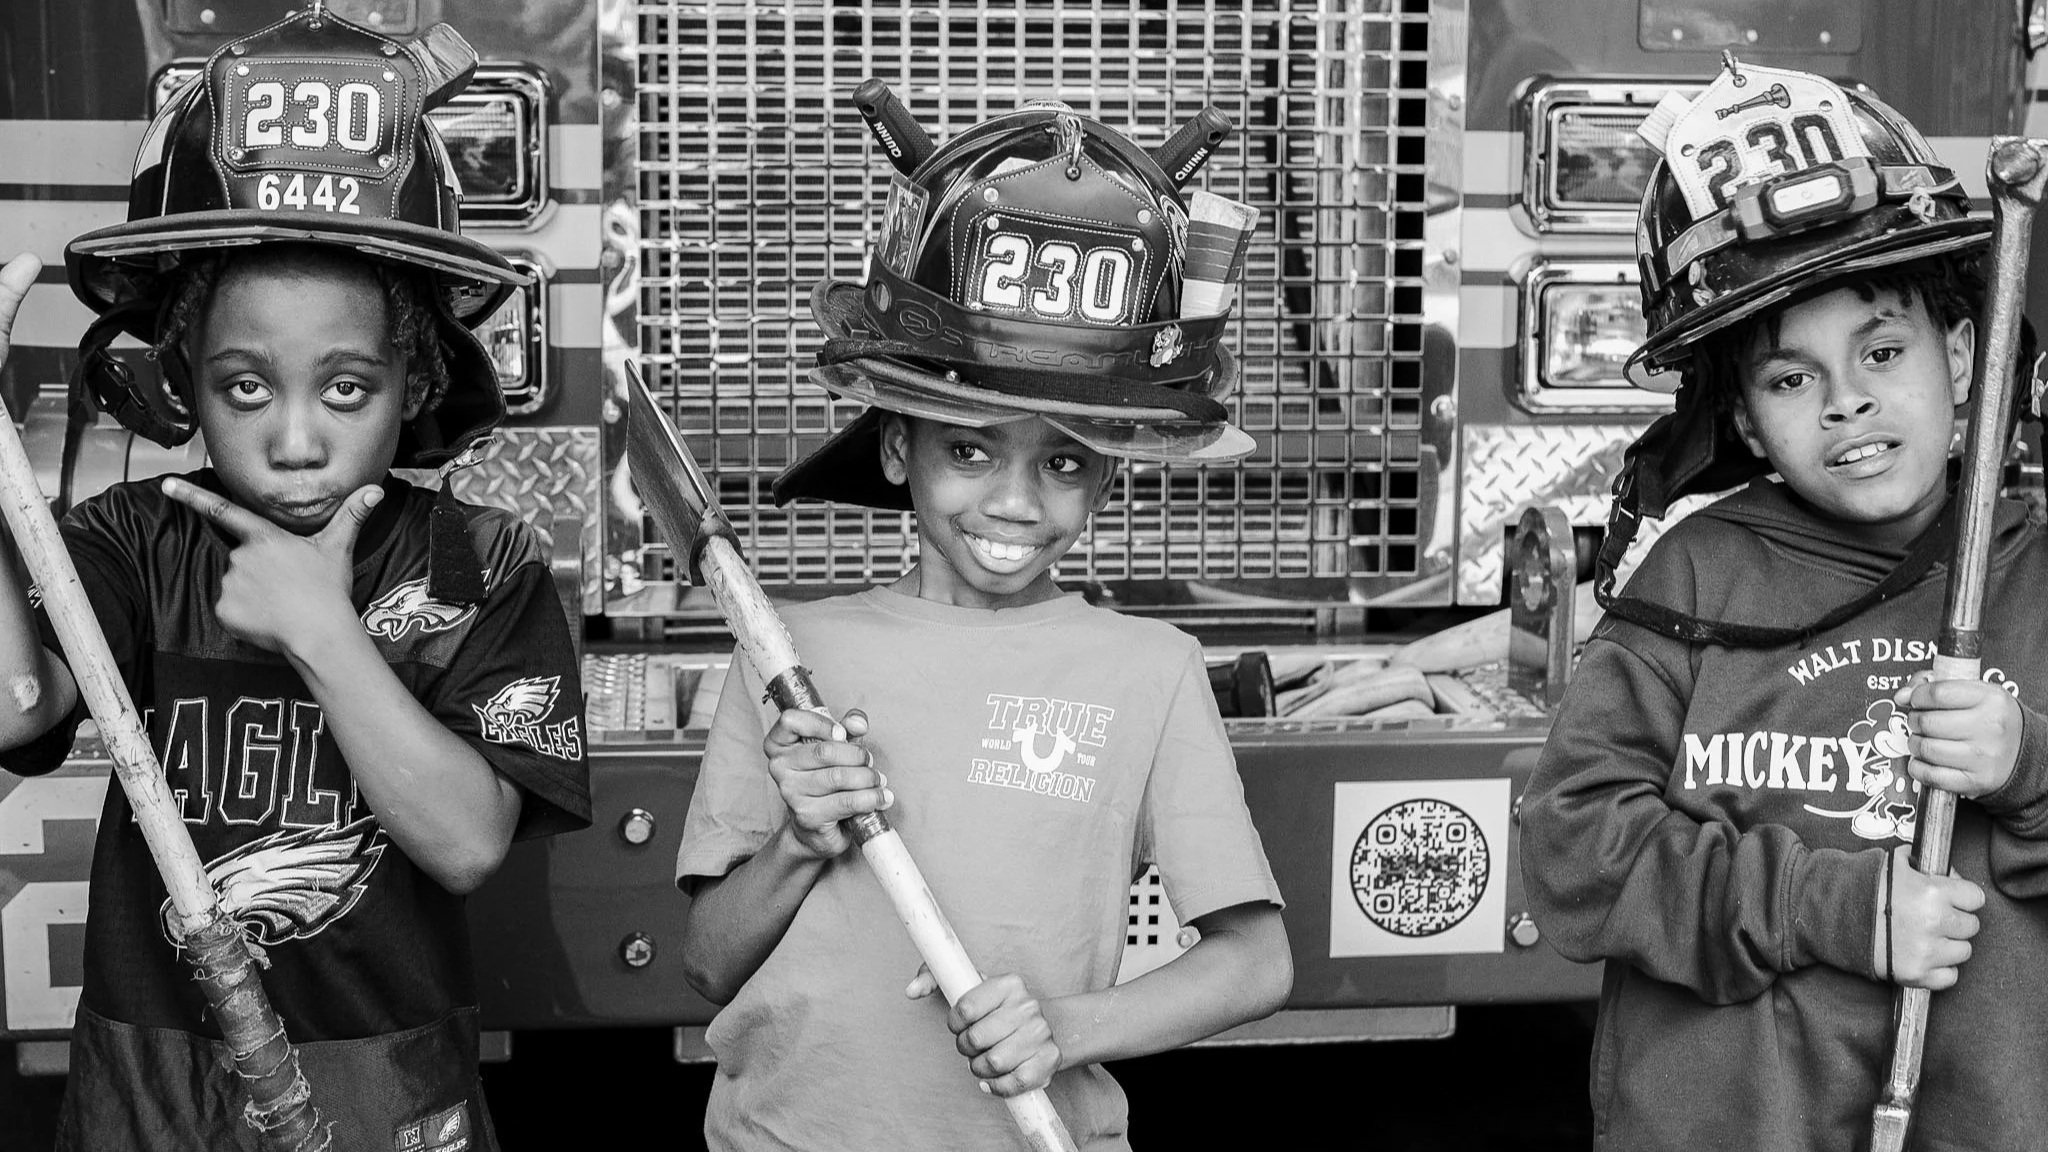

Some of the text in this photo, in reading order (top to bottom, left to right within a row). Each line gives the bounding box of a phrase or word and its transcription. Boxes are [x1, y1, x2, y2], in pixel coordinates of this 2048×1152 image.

[245, 81, 381, 151] 230
[873, 121, 902, 158] QUINN
[1175, 147, 1208, 181] QUINN
[1697, 114, 1844, 209] 230
[257, 173, 361, 215] 6442
[981, 234, 1130, 321] 230
[1787, 639, 1862, 687] WALT
[471, 703, 582, 761] EAGLES
[986, 693, 1115, 748] TRUE
[981, 738, 1097, 767] WORLD TOUR
[1683, 730, 1870, 793] MICKEY
[967, 758, 1096, 803] RELIGION
